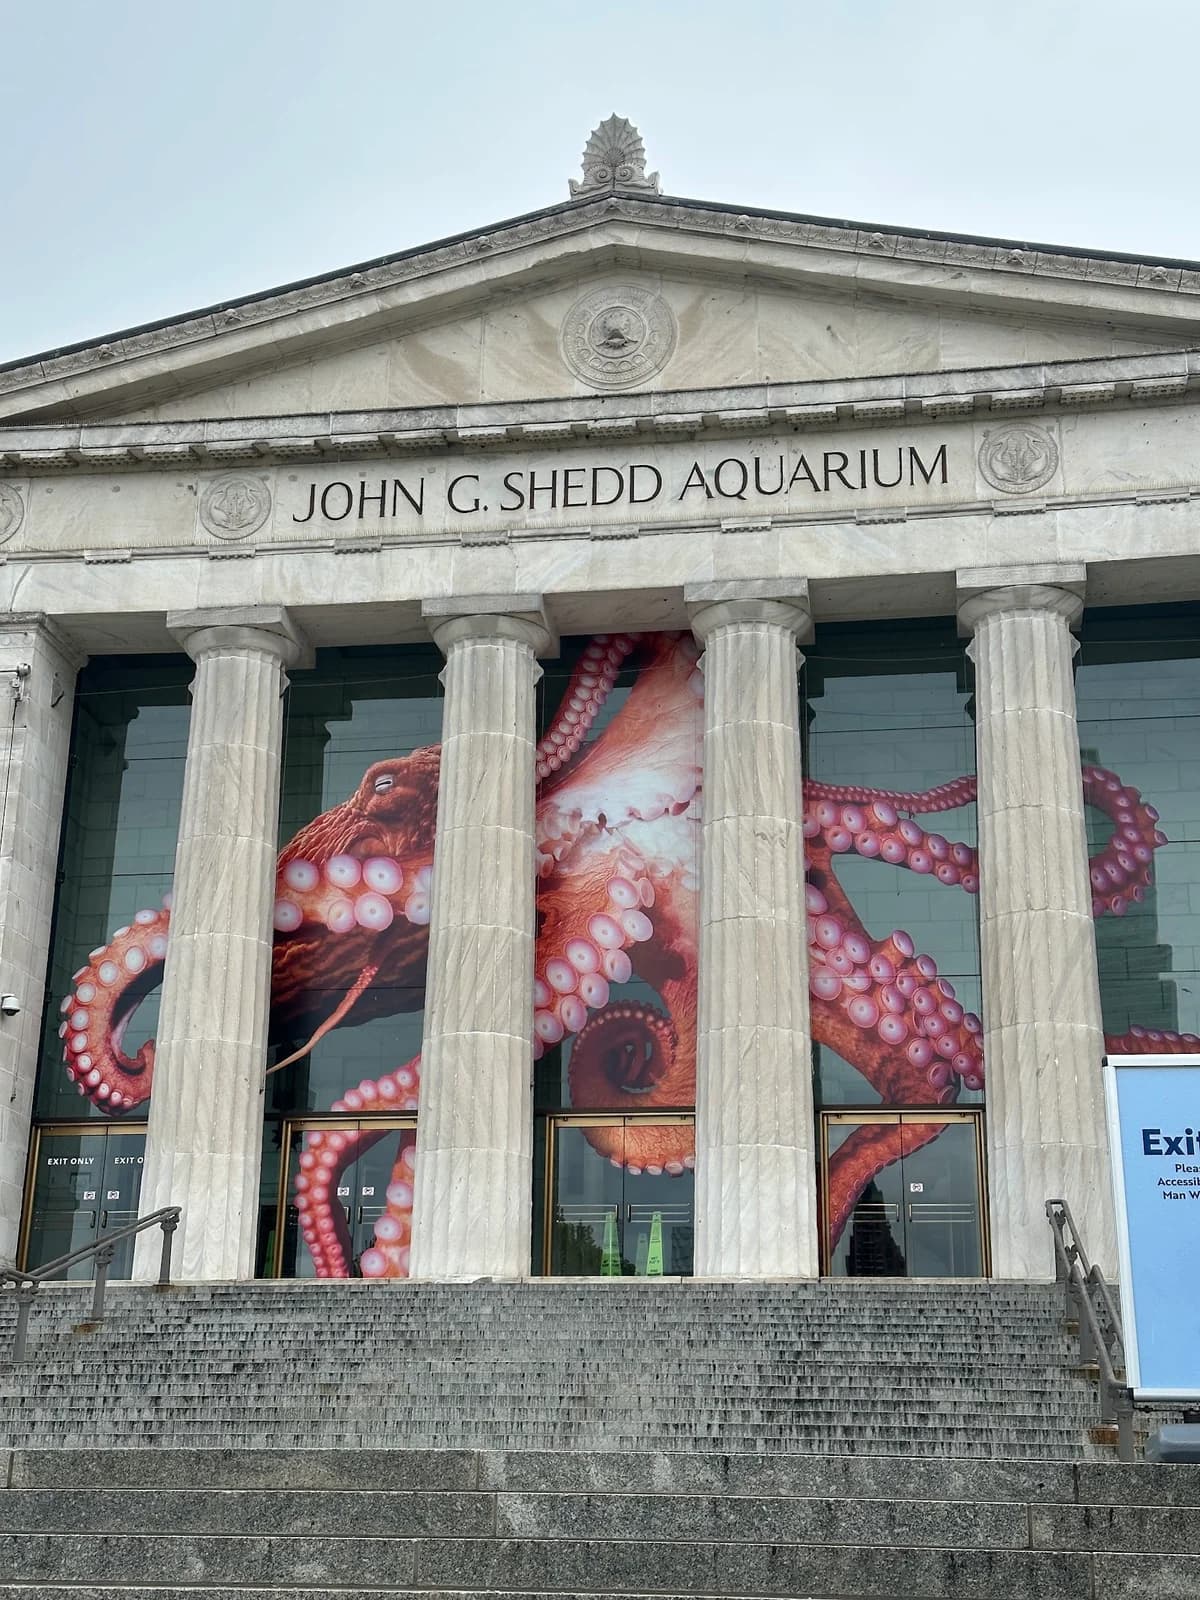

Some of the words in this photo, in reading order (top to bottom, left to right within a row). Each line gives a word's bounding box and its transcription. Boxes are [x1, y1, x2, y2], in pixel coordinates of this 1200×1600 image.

[293, 478, 424, 522] JOHN
[448, 474, 488, 513] G.
[500, 465, 662, 511] SHEDD
[678, 445, 948, 500] AQUARIUM
[1175, 1164, 1200, 1172] Plea
[1163, 1190, 1186, 1200] Man
